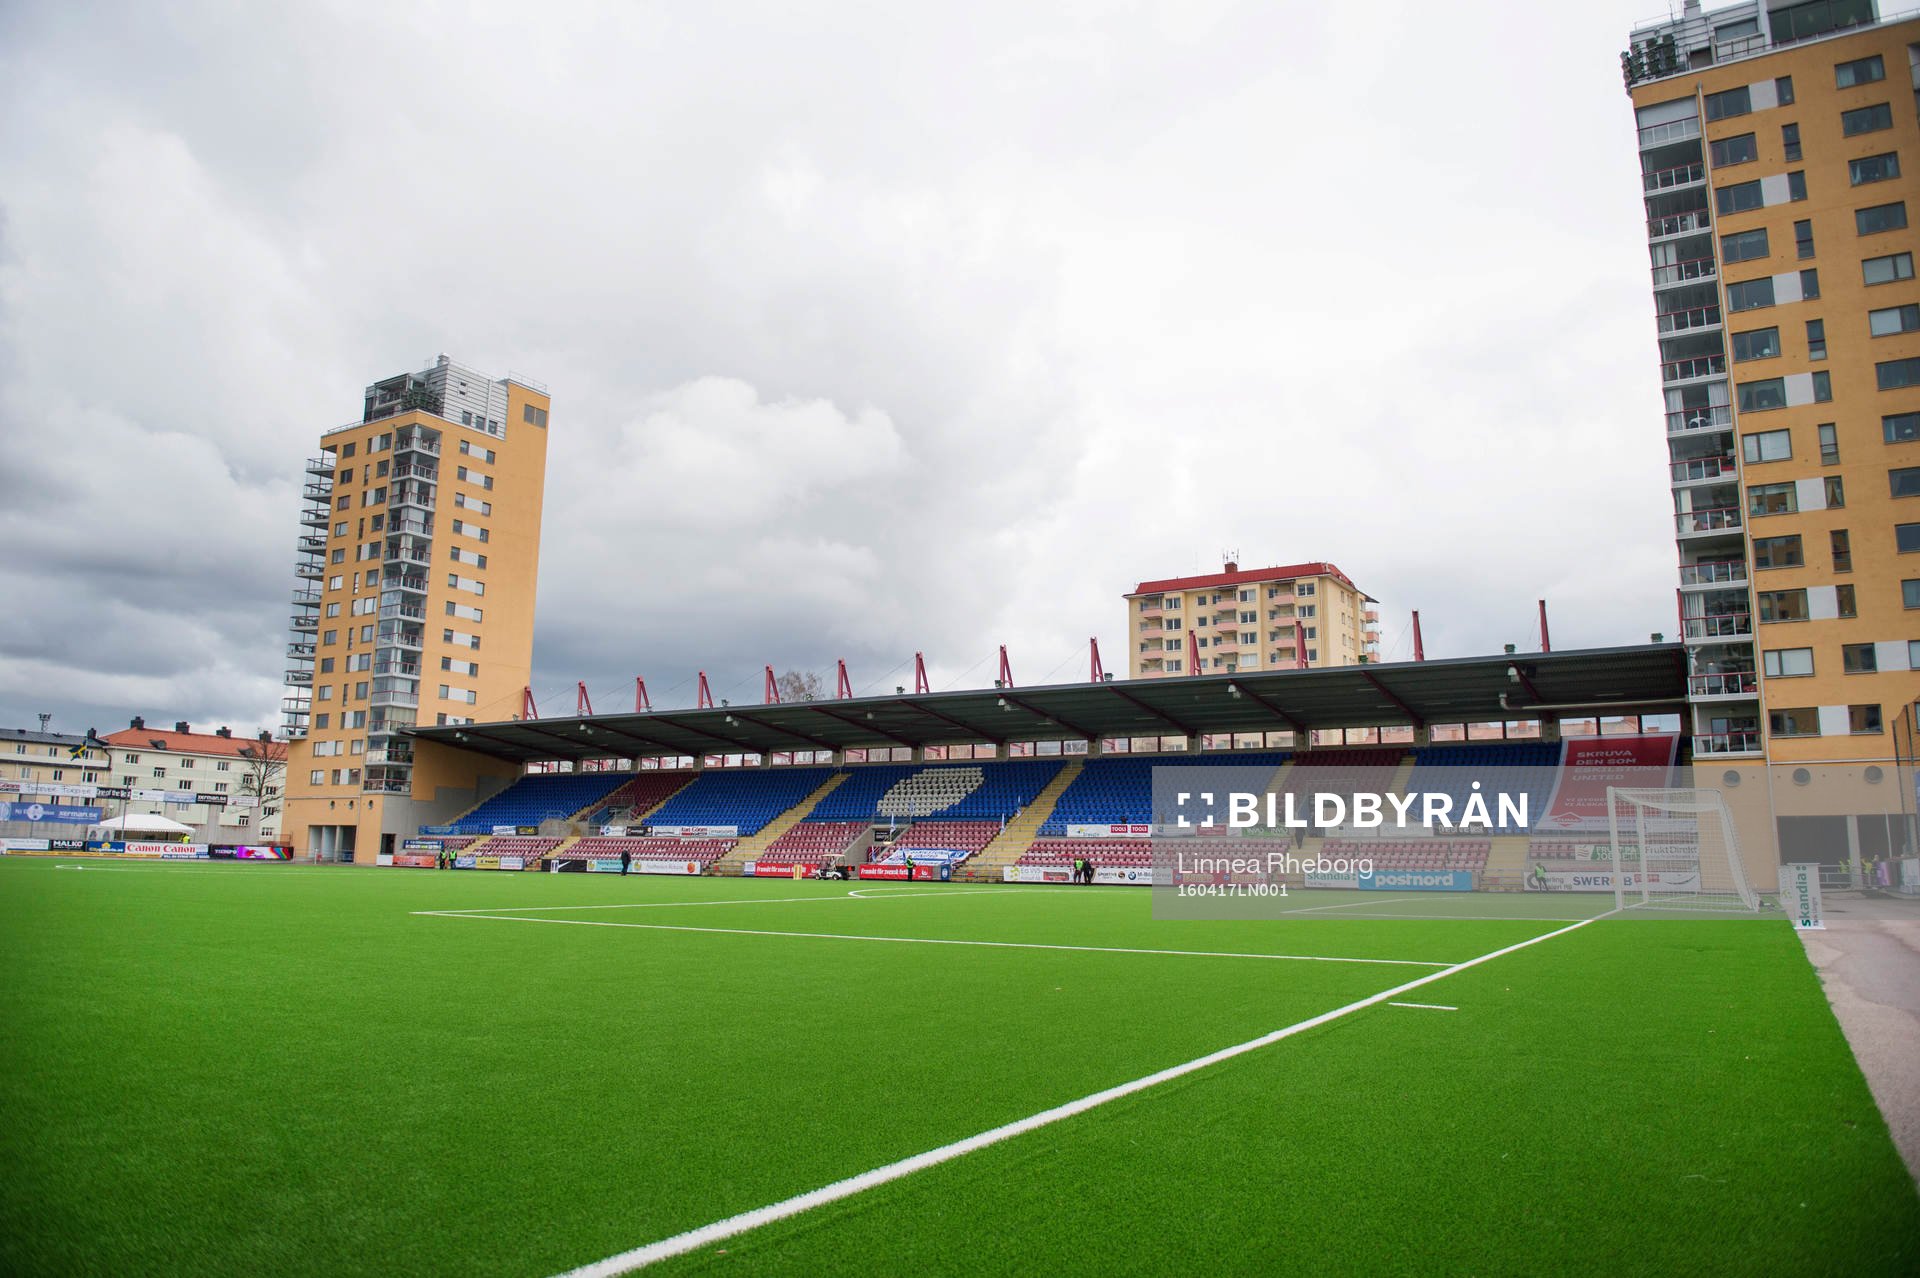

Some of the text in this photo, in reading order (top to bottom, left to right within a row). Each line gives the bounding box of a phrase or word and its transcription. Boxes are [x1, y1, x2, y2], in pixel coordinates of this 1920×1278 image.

[1576, 750, 1633, 758] SKRUVA
[1572, 774, 1625, 782] UNITED
[53, 840, 83, 848] MALKO
[127, 843, 161, 853] Canon
[163, 844, 196, 853] Canon
[1307, 871, 1351, 881] skandia
[1375, 873, 1454, 887] postnord
[1573, 876, 1633, 886] SWERB
[1795, 874, 1812, 927] skandia
